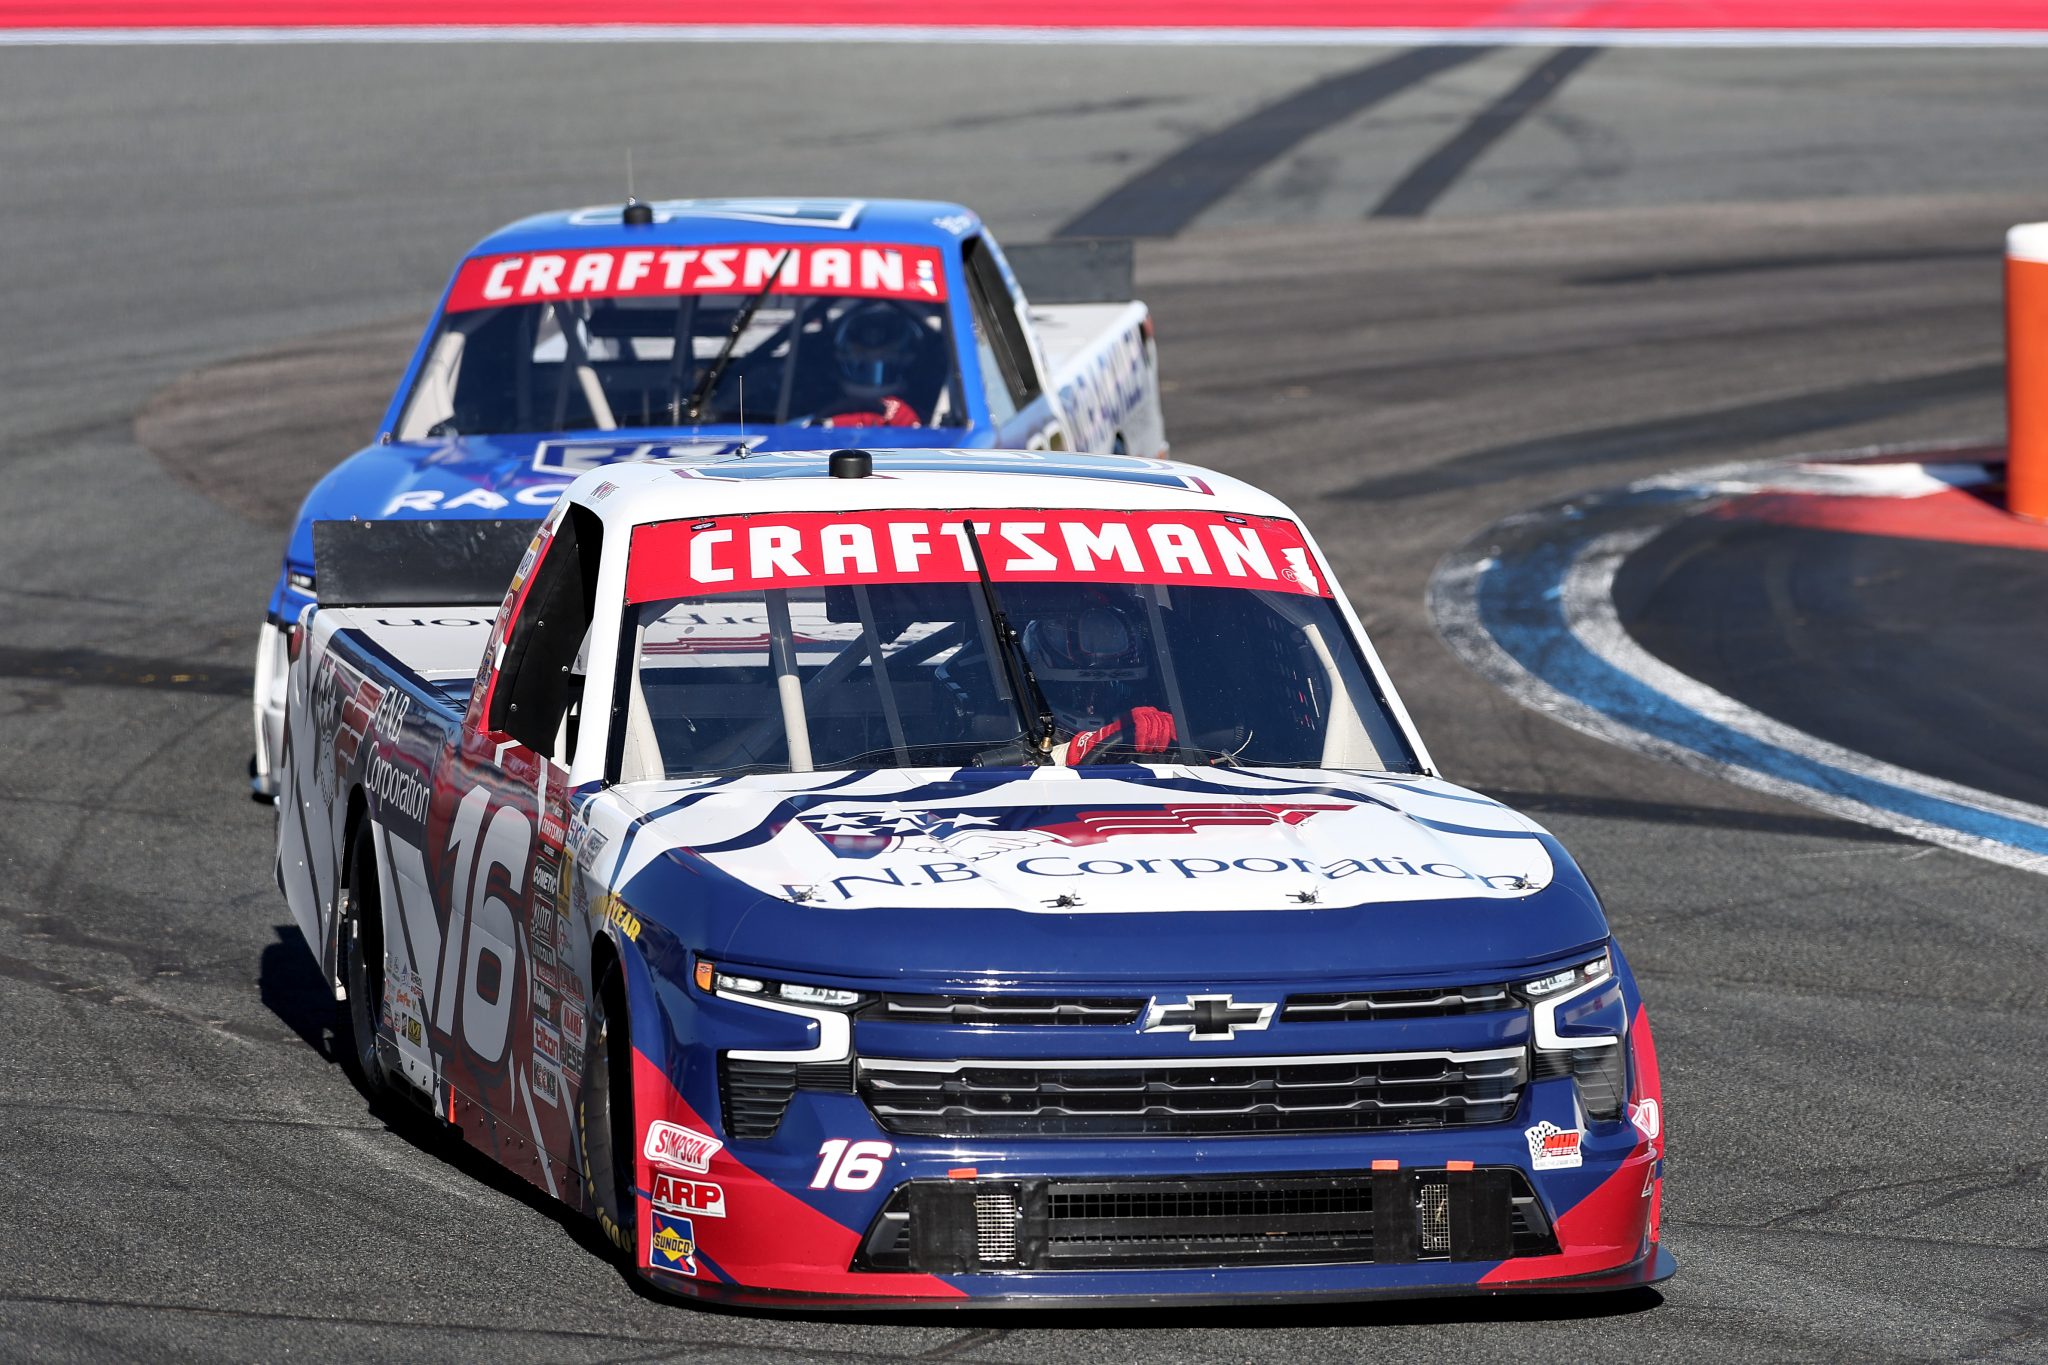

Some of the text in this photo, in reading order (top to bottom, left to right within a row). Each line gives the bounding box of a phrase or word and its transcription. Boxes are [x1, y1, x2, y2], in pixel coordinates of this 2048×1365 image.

[484, 247, 904, 300] CRAFTSMAN
[690, 522, 1279, 584] CRAFTSMAN
[364, 741, 431, 825] Corporation
[541, 816, 566, 845] CRAFTSMAN
[533, 865, 557, 895] COMETIC
[1016, 855, 1541, 890] Corporation
[436, 785, 532, 1062] 16
[534, 901, 552, 934] KLOTZ
[532, 942, 553, 967] LINCOLN
[655, 1128, 712, 1165] SIMPSON
[1544, 1133, 1579, 1149] MUD
[810, 1139, 893, 1191] 16
[654, 1176, 721, 1209] ARP
[654, 1234, 691, 1254] SUNOCO
